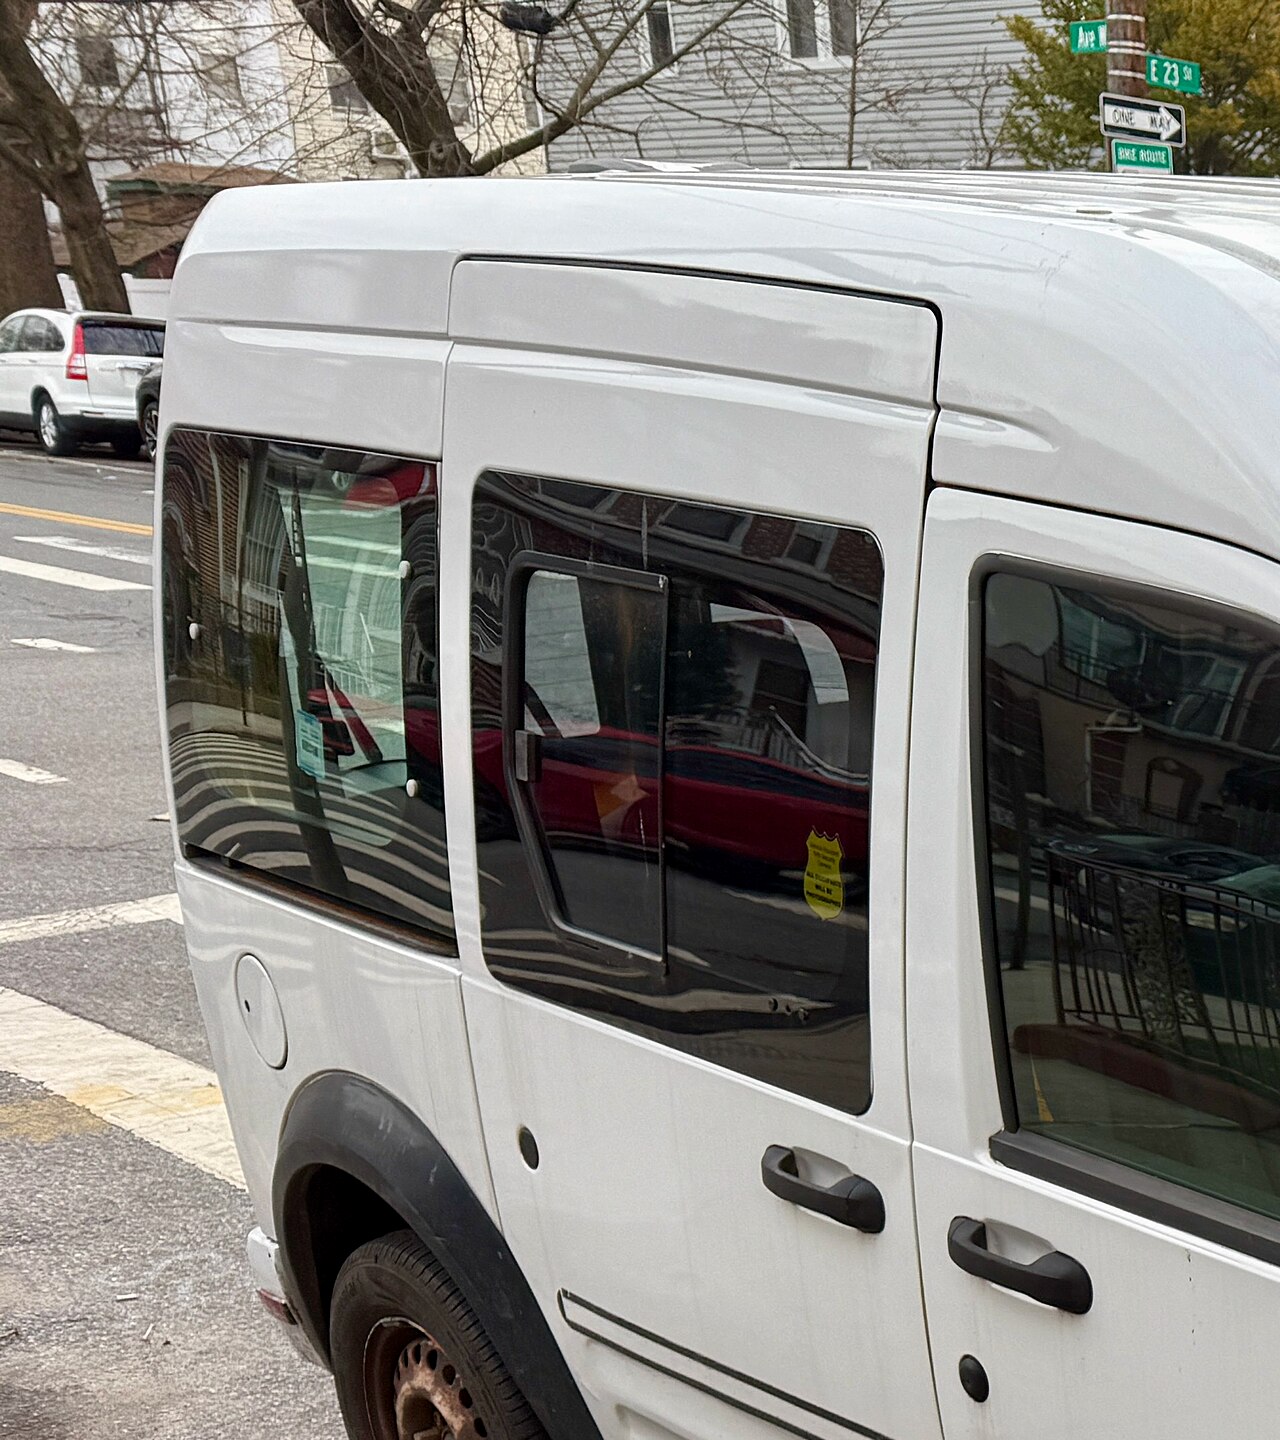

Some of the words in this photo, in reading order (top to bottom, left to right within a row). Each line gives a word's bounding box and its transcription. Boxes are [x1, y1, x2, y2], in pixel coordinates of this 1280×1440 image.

[1077, 26, 1095, 49] Ave
[1150, 59, 1159, 82] E
[1163, 61, 1180, 87] 23
[1112, 108, 1136, 126] ONE
[1148, 113, 1172, 132] WAY
